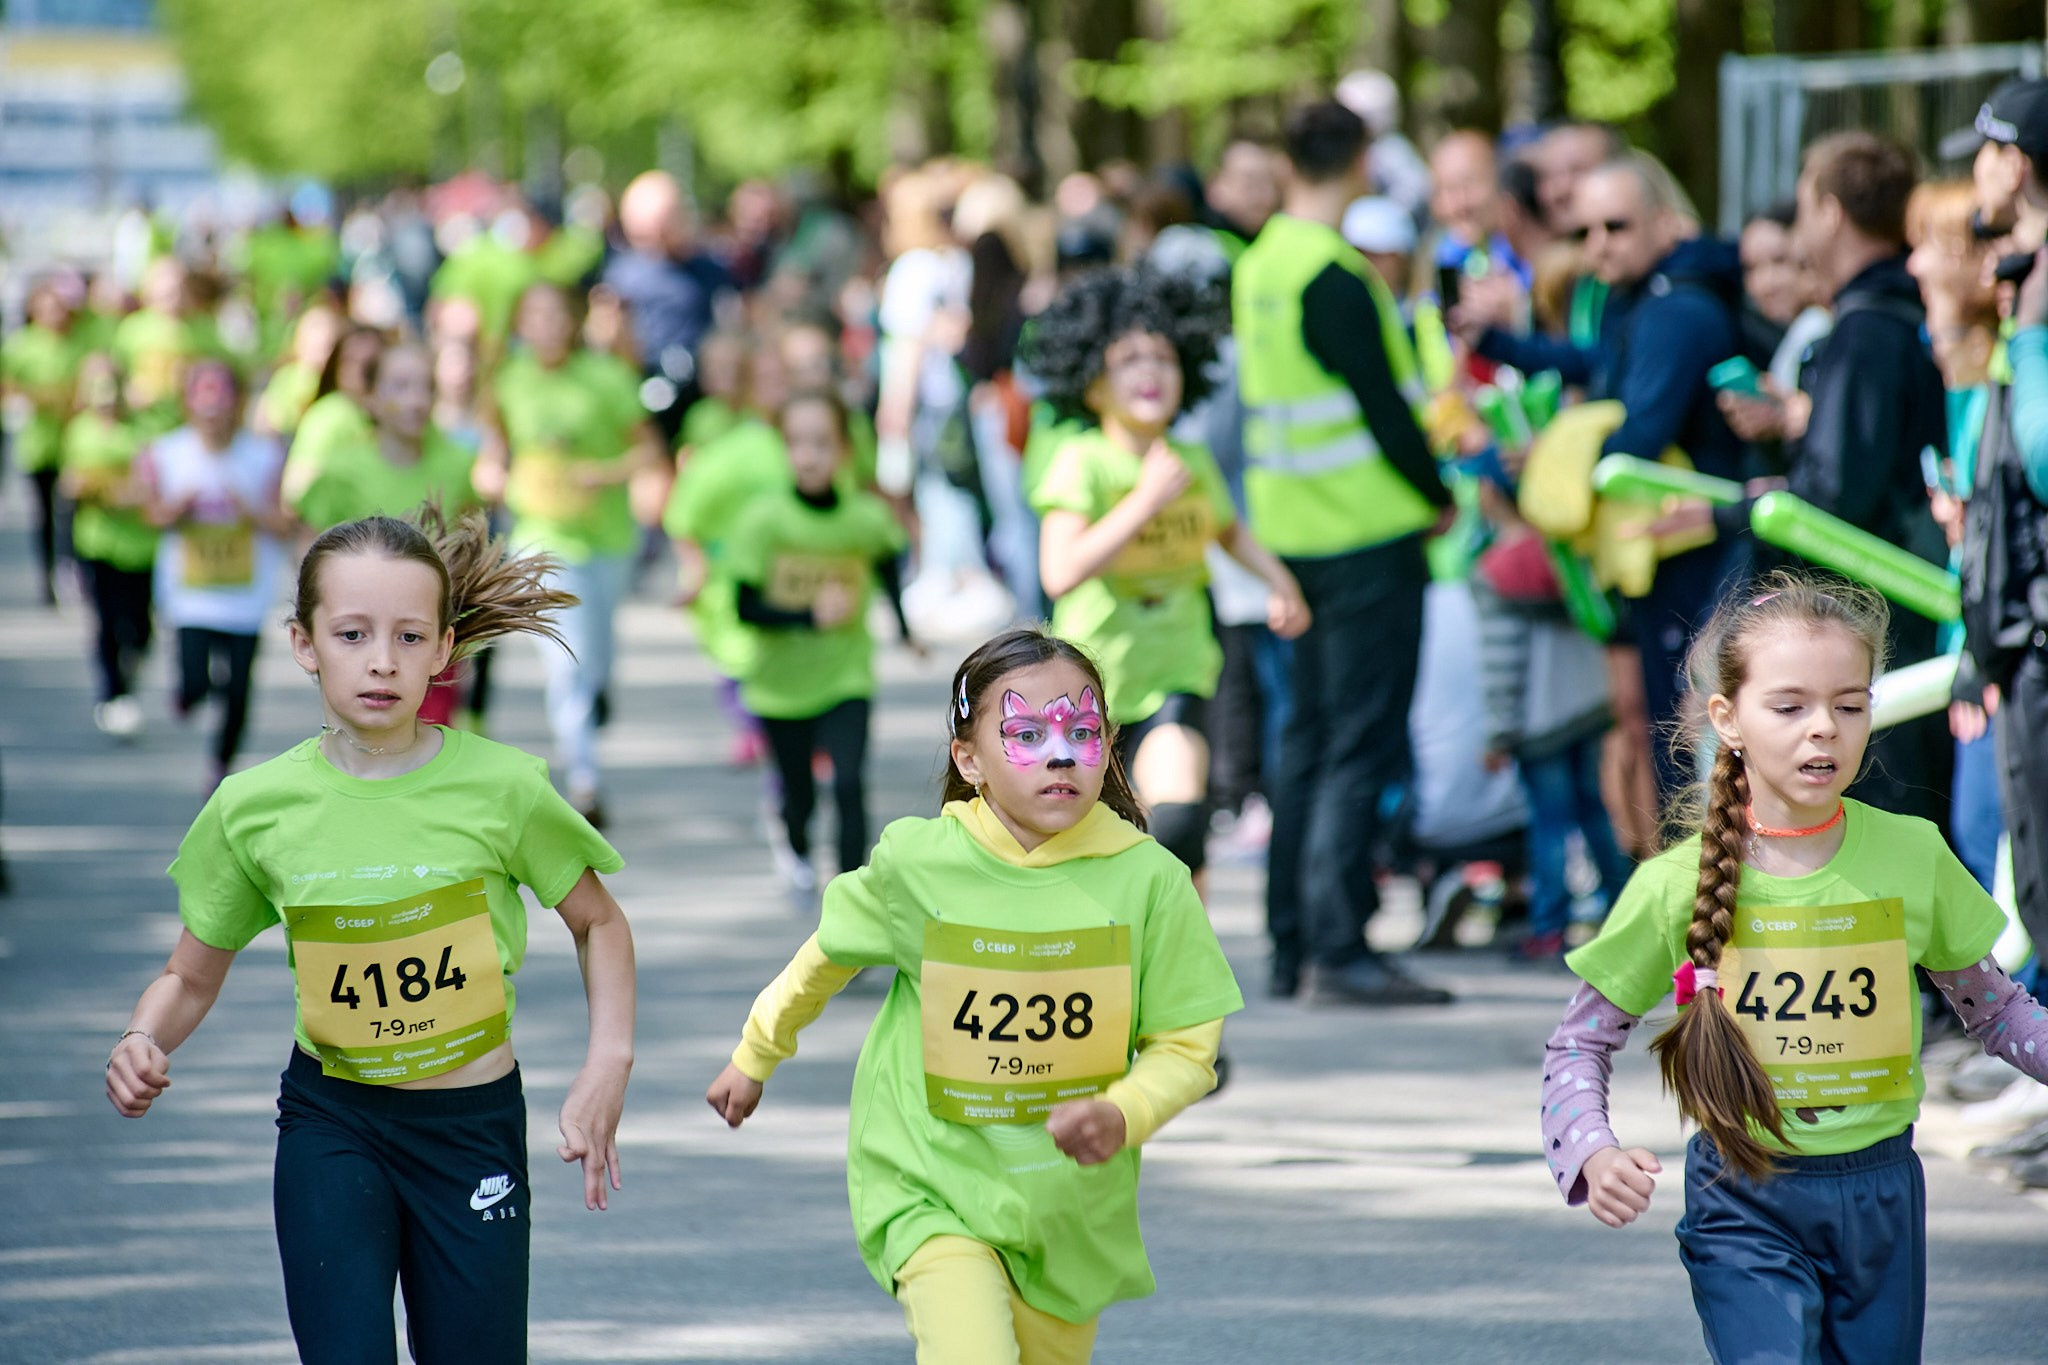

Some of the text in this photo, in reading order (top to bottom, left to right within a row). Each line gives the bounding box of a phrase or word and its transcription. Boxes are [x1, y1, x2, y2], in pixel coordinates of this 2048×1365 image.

[347, 918, 376, 929] СБЕР
[1767, 920, 1798, 932] СБЕР
[987, 943, 1016, 954] СБЕР
[330, 945, 467, 1010] 4184
[1736, 967, 1878, 1022] 4243
[953, 990, 1093, 1043] 4238
[369, 1017, 436, 1039] 7-9 лет
[1776, 1036, 1844, 1056] 7-9 лет
[988, 1056, 1054, 1076] 7-9 лет
[478, 1174, 510, 1197] NIKE
